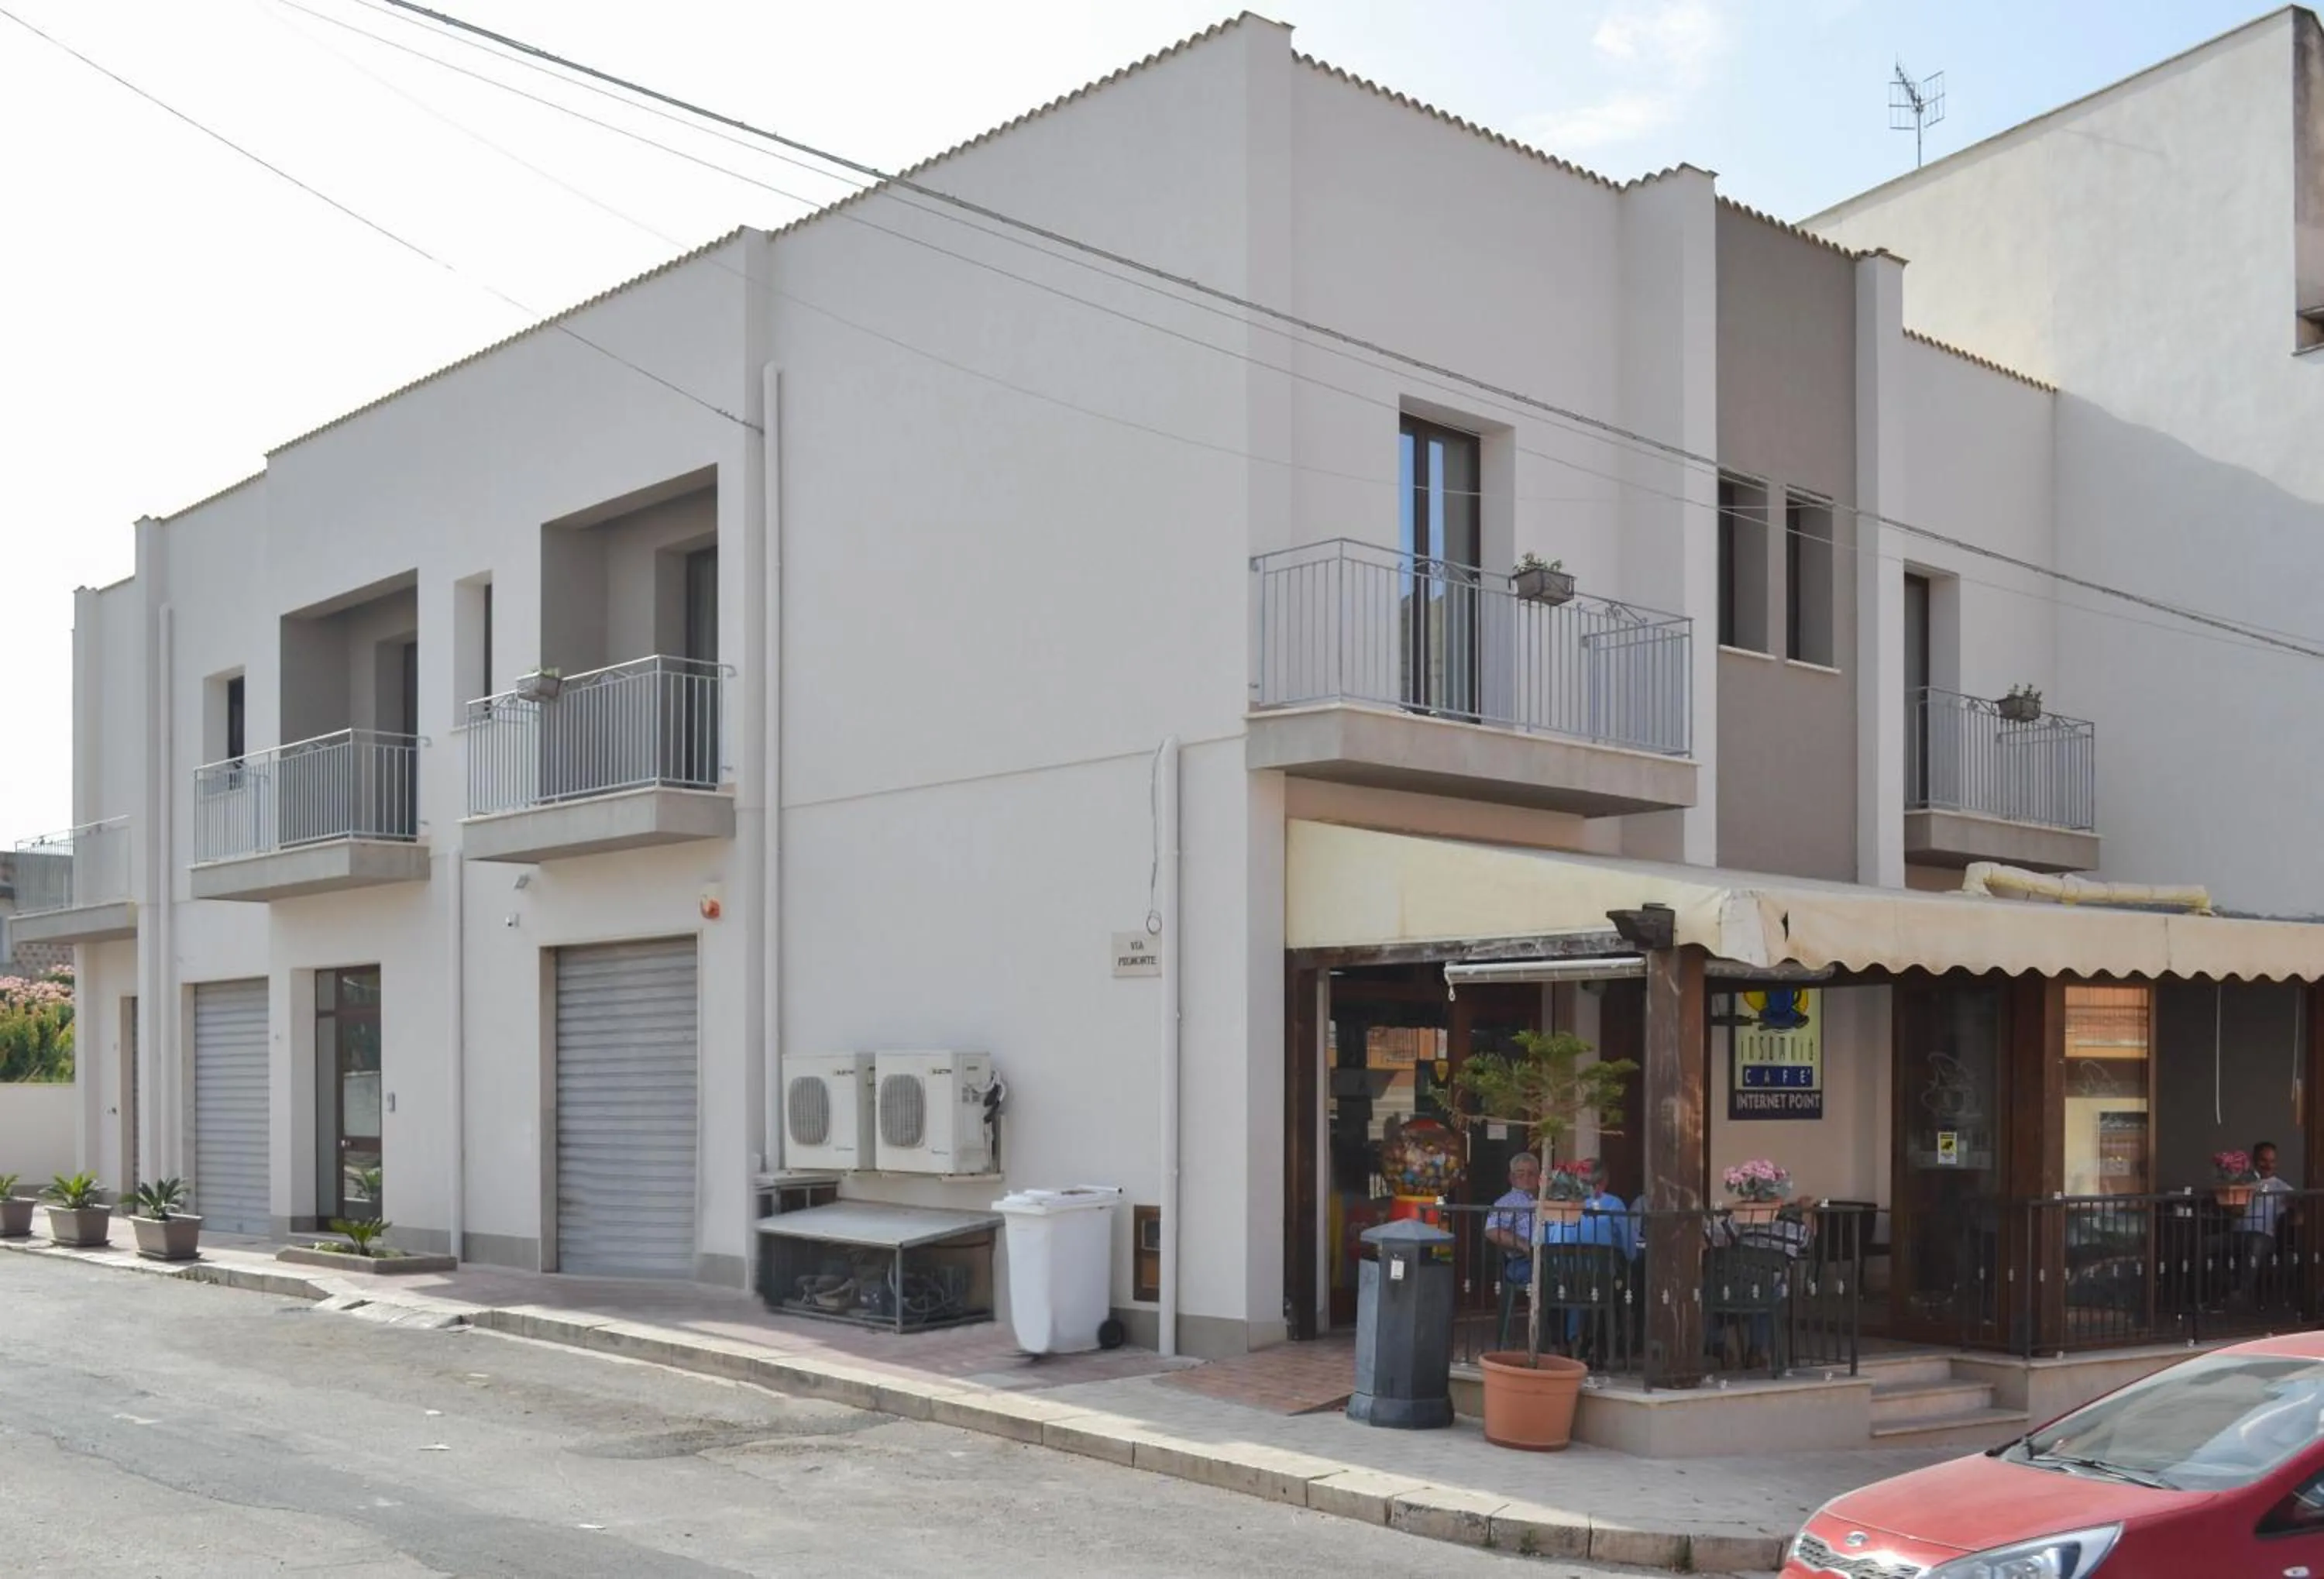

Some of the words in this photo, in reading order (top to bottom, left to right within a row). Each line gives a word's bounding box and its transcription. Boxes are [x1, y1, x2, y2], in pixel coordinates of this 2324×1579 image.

[1130, 941, 1144, 951] VIA
[1118, 955, 1157, 966] PIEMONTE
[1736, 1093, 1787, 1109] INTERNET
[1789, 1093, 1820, 1109] POINT
